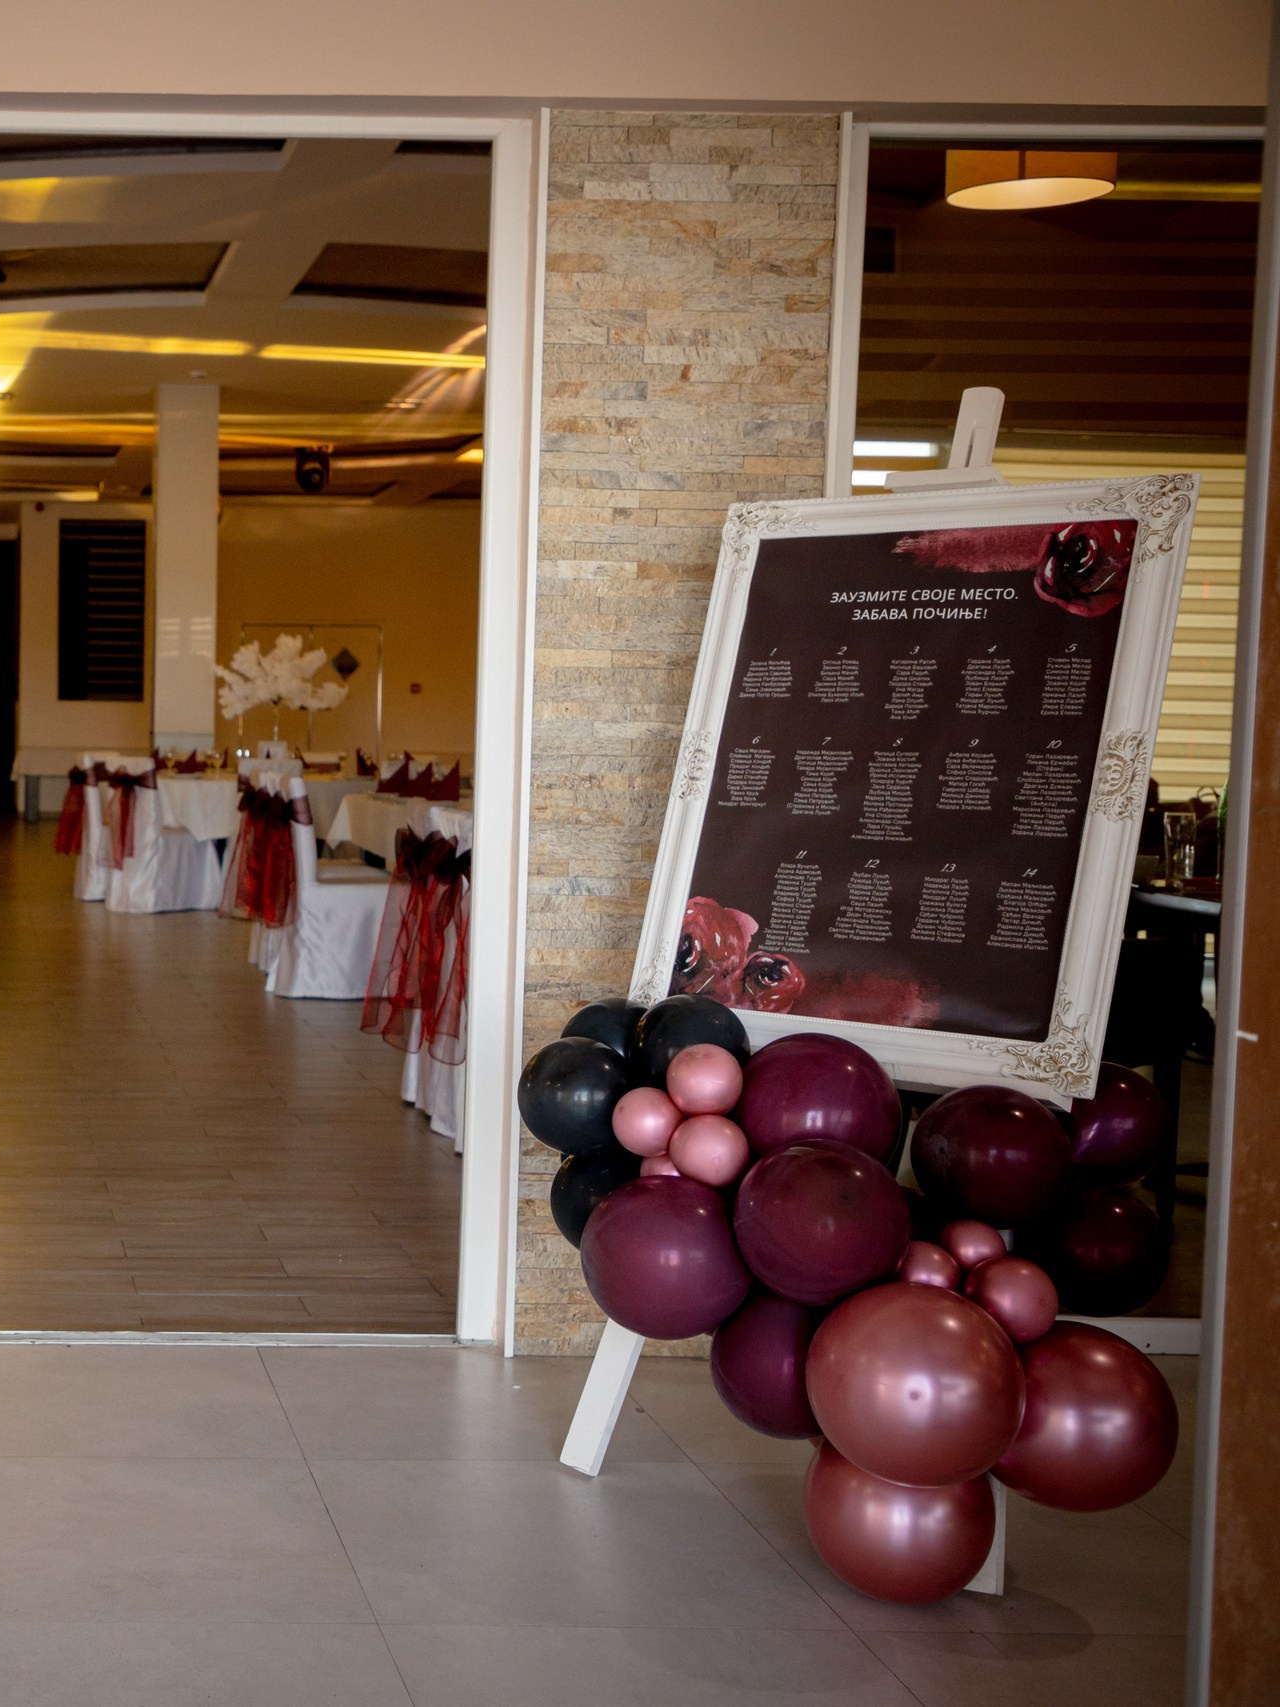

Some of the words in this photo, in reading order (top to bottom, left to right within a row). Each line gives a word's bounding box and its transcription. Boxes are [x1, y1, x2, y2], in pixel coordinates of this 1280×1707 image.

[830, 590, 907, 603] ЗАУЗМИТЕ
[911, 589, 956, 603] СВОЈЕ
[960, 588, 1019, 601] МЕСТО.
[852, 608, 908, 620] ЗАБАВА
[912, 607, 988, 620] ПОЧИЊЕ!
[770, 648, 777, 656] 1
[836, 646, 847, 655] 2
[909, 645, 920, 655] 3
[987, 645, 997, 654] 4
[1065, 644, 1078, 653] 5
[752, 736, 761, 745] 6
[821, 737, 831, 746] 7
[893, 737, 904, 747] 8
[968, 738, 979, 748] 9
[1045, 739, 1062, 749] 10
[795, 850, 807, 859] 11
[863, 859, 880, 868] 12
[940, 863, 956, 872] 13
[1021, 868, 1038, 877] 14
